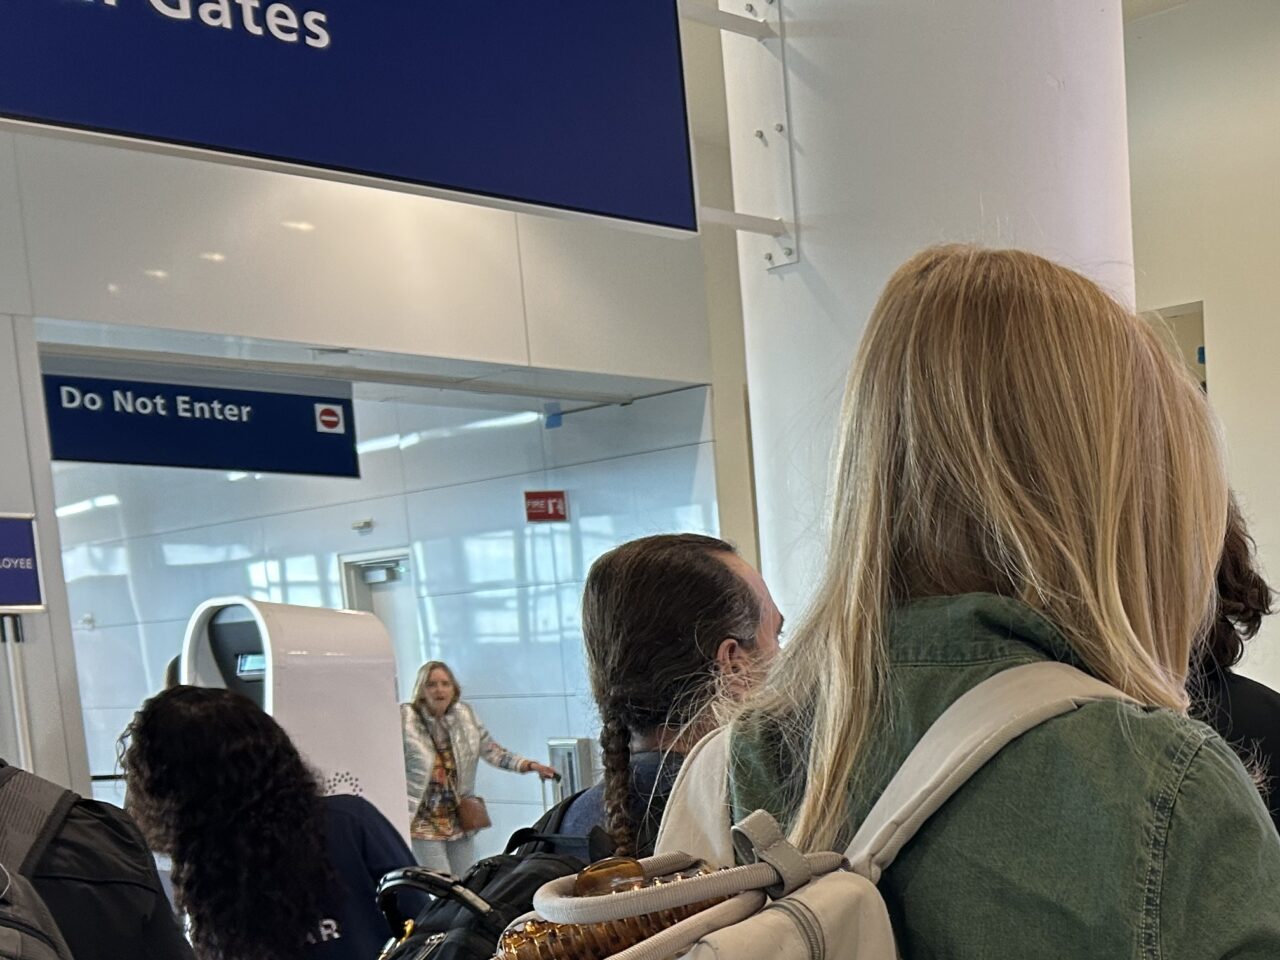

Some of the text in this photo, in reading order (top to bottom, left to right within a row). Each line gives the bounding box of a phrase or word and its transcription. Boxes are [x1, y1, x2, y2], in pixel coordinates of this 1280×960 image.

[59, 385, 252, 422] Do Not Enter
[0, 557, 33, 570] OYEE
